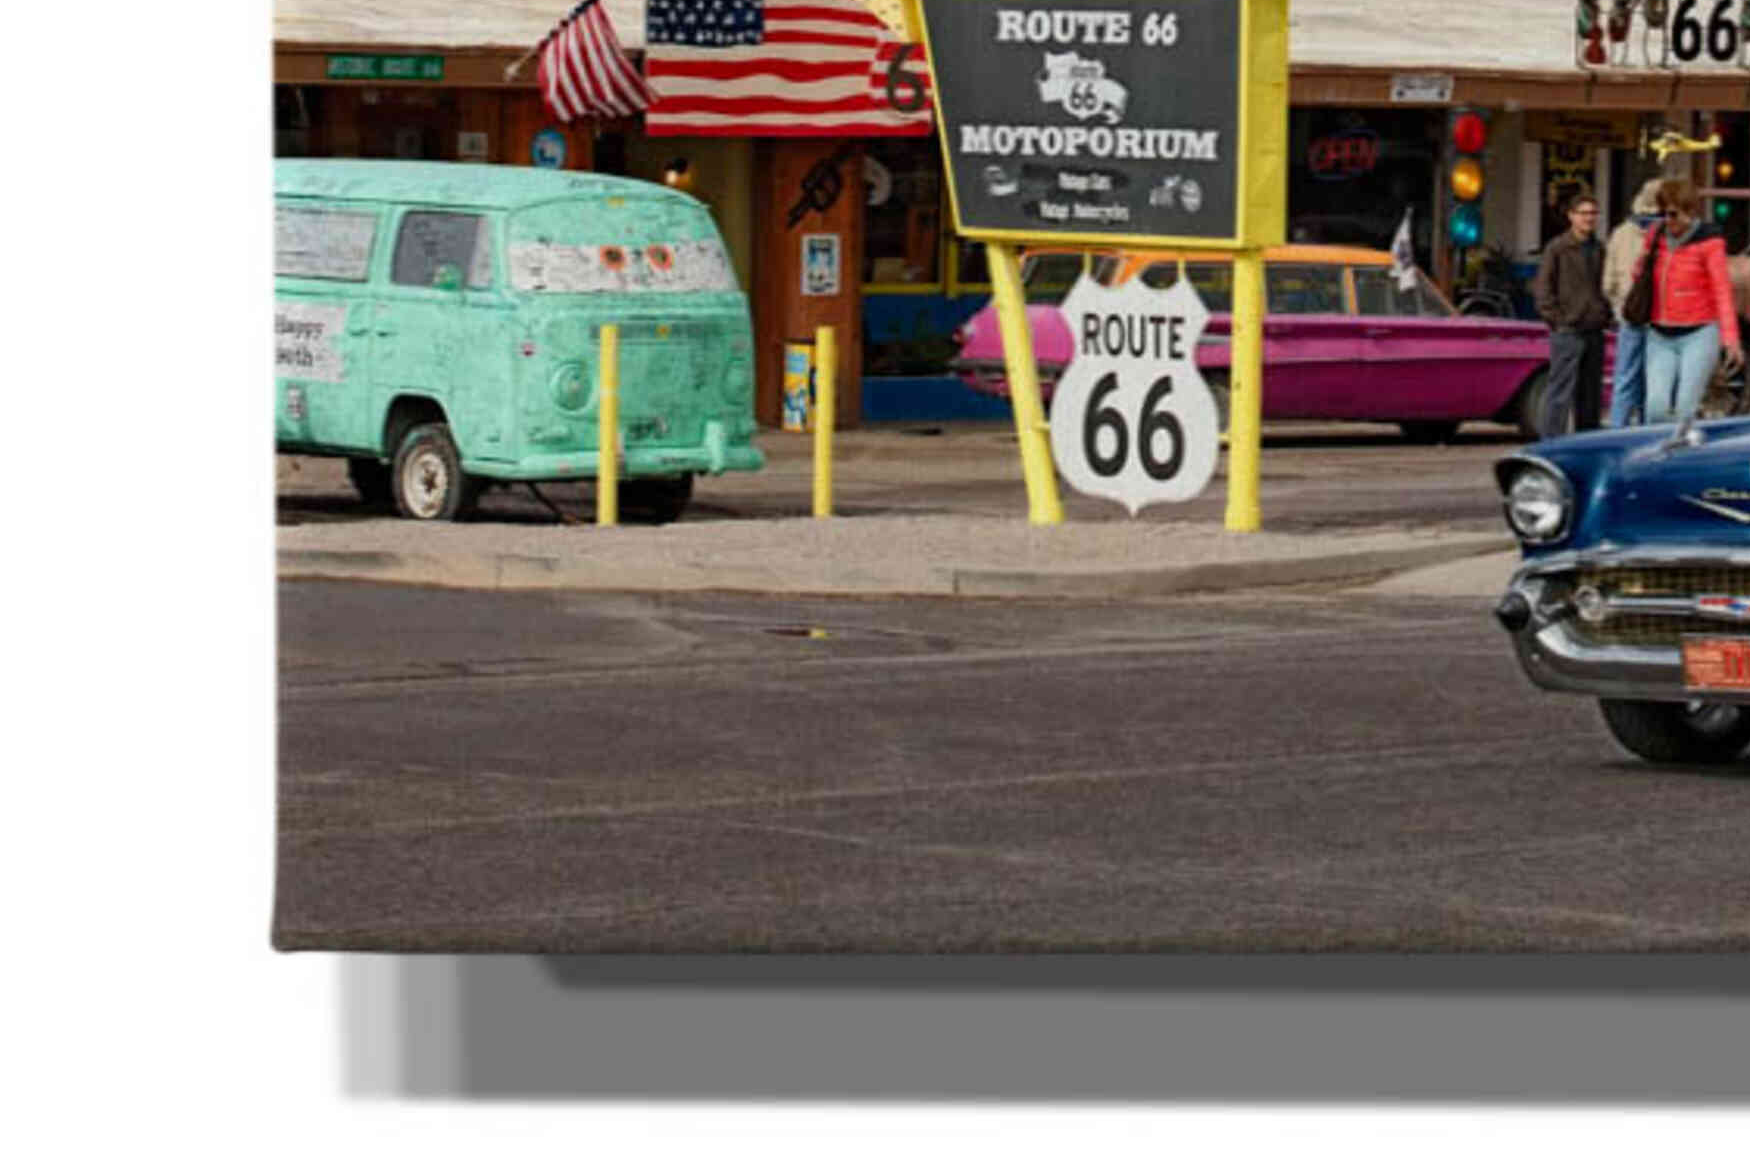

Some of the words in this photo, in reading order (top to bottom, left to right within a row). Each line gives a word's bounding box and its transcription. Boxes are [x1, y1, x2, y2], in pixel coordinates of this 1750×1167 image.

[996, 9, 1132, 44] ROUTE
[1142, 13, 1178, 46] 66
[1070, 81, 1099, 110] 66
[961, 125, 1219, 160] MOTOPORIUM
[1082, 312, 1186, 360] ROUTE
[1083, 371, 1185, 481] 66
